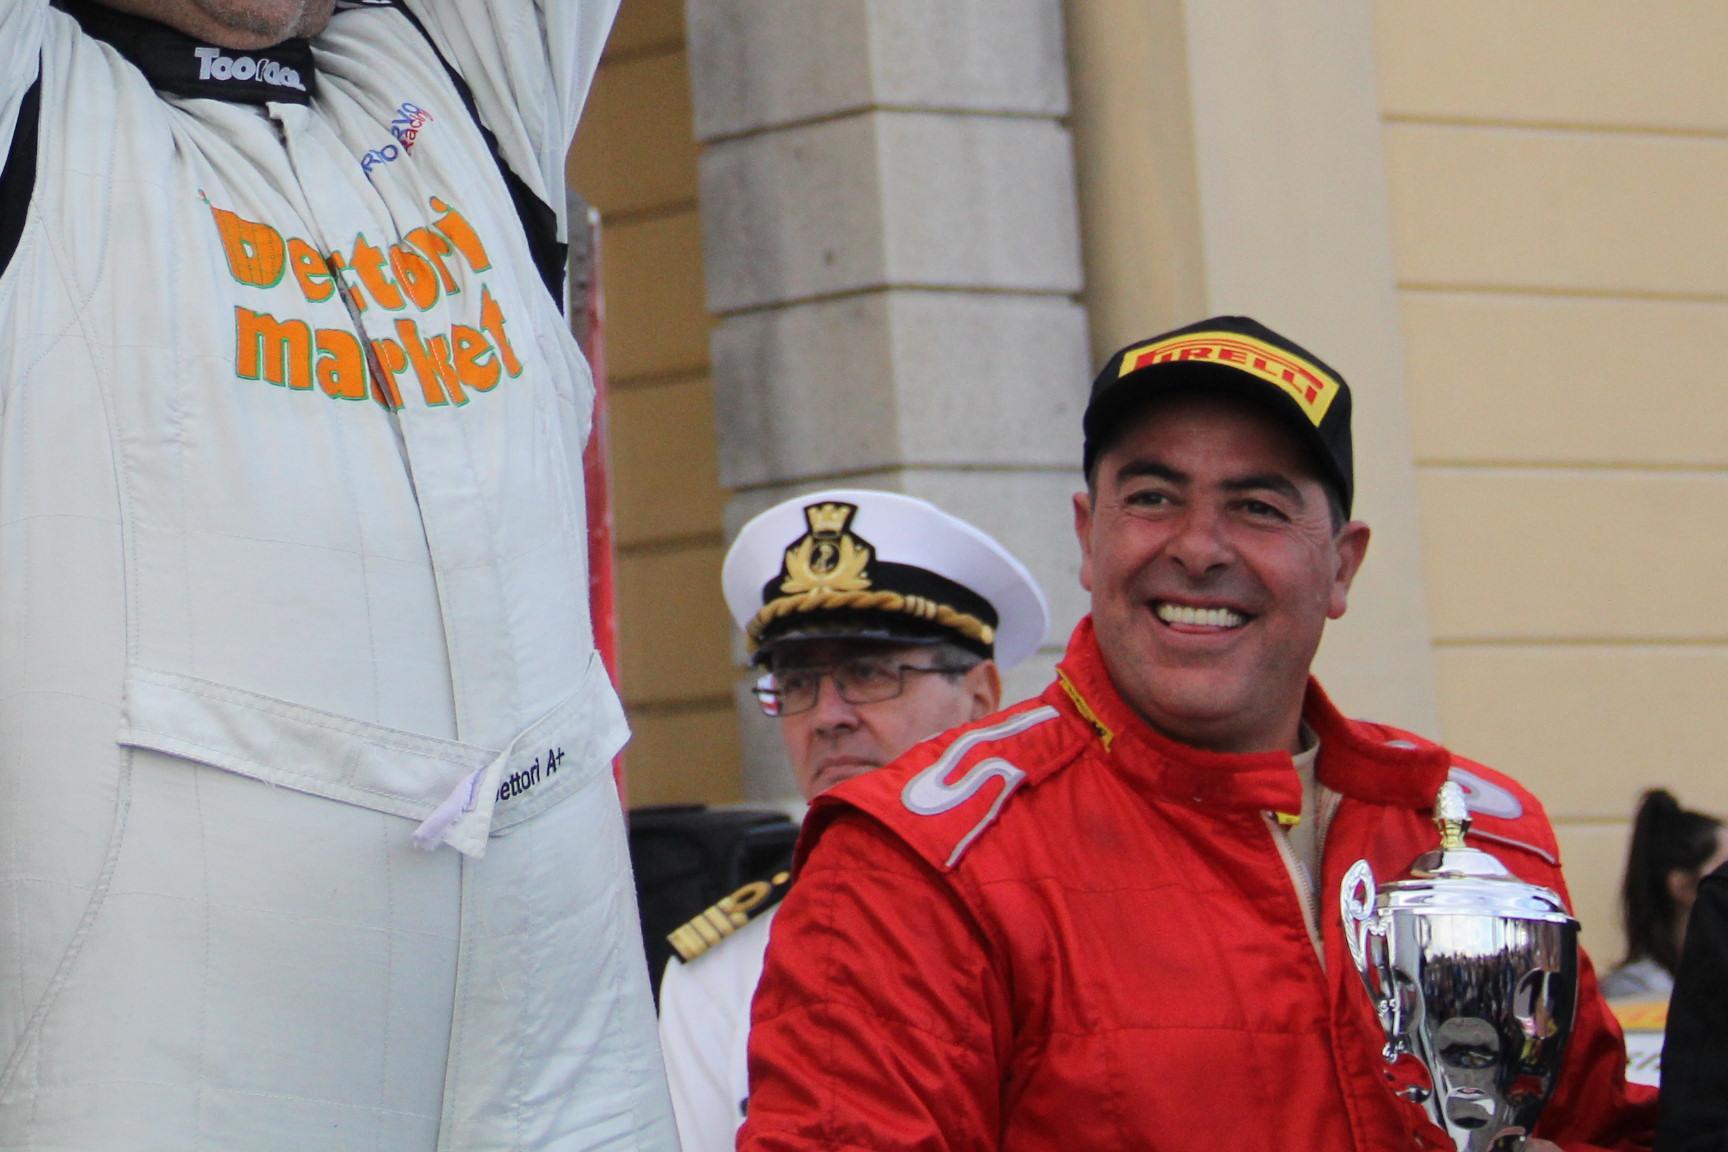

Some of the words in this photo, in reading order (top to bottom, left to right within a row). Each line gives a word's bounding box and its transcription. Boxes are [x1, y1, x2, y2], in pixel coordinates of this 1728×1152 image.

[233, 283, 523, 414] market
[1133, 338, 1324, 406] PIRELLI
[495, 757, 540, 803] ettori
[546, 746, 566, 777] A+
